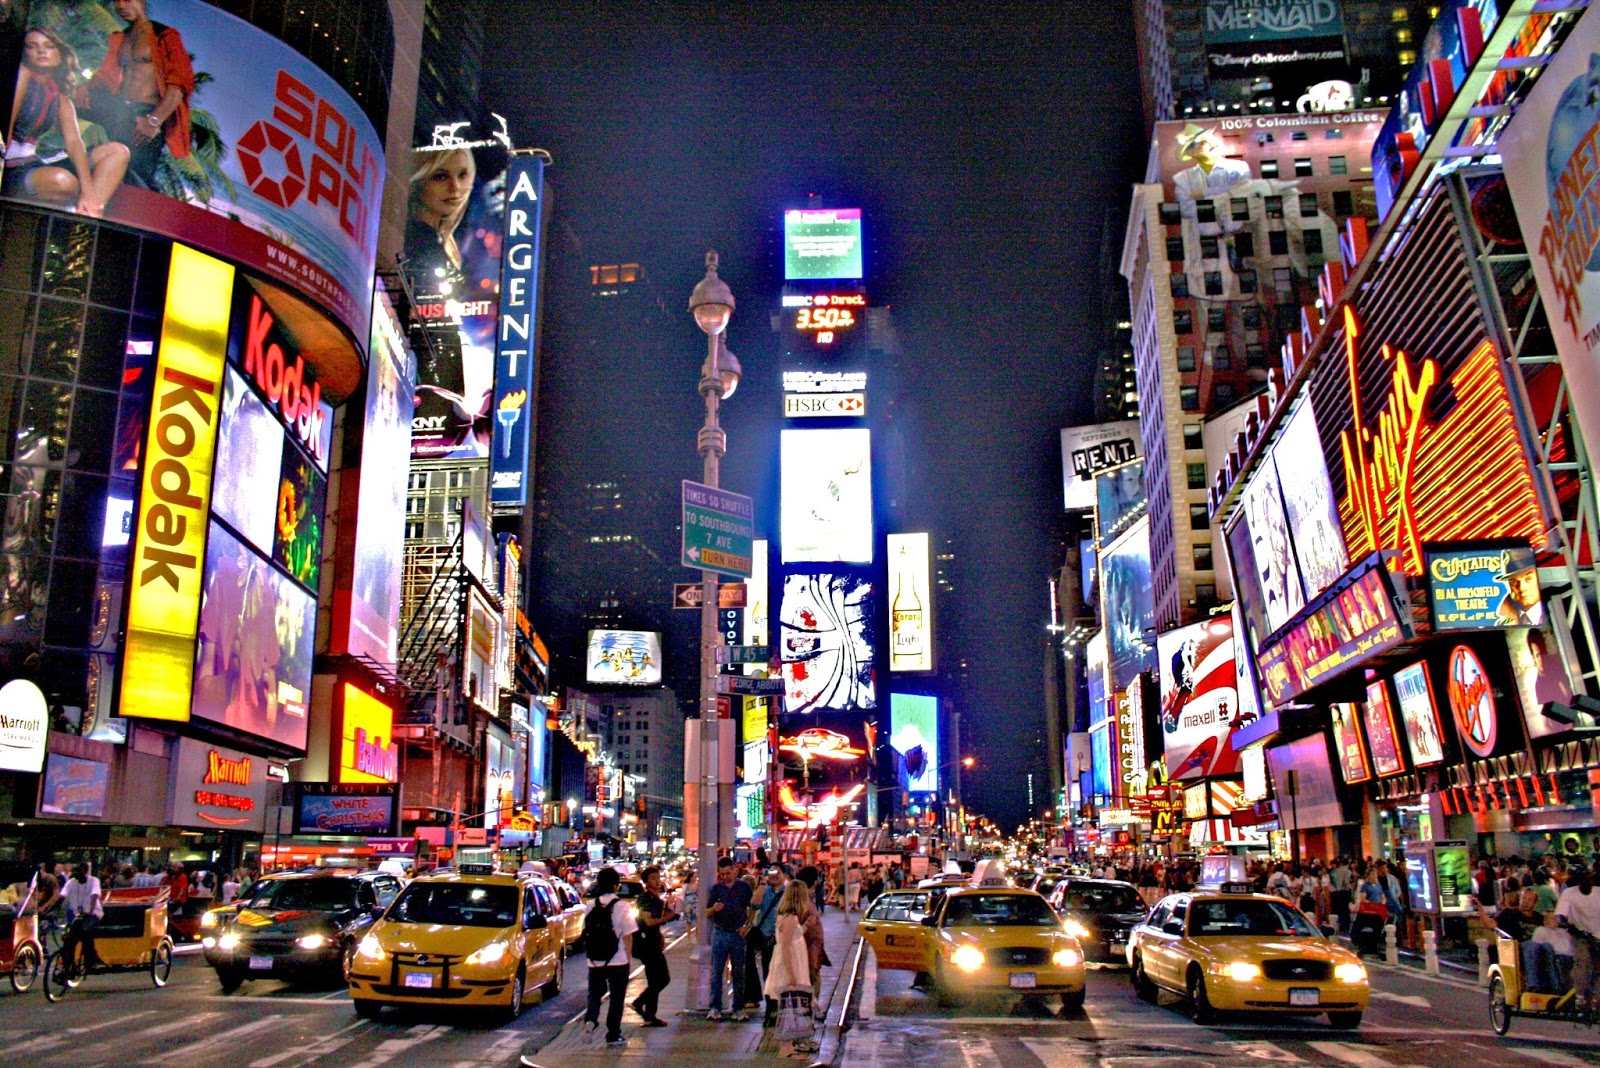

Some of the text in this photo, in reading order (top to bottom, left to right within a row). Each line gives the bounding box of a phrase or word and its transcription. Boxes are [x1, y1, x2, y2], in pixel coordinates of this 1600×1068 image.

[1206, 0, 1337, 31] MERMAID
[1221, 118, 1253, 130] 100%
[1256, 113, 1330, 128] Colombian
[501, 171, 537, 377] ARGENT
[244, 295, 326, 462] Kodak
[787, 398, 834, 412] HSBC
[1074, 442, 1130, 470] RENT
[140, 367, 214, 593] Kodak
[686, 489, 706, 504] TIMES
[709, 494, 720, 507] SQ
[686, 511, 751, 537] TO SOUTHBOUND
[706, 533, 732, 549] 7 AVE
[703, 550, 748, 570] TURN HERE
[733, 648, 741, 661] W
[744, 648, 756, 661] 45
[730, 678, 784, 690] GEORGE ABBOTT
[1184, 709, 1215, 728] maxell
[203, 750, 251, 785] Marriott
[330, 798, 369, 810] WHITE
[317, 809, 385, 829] CHRISTMAS
